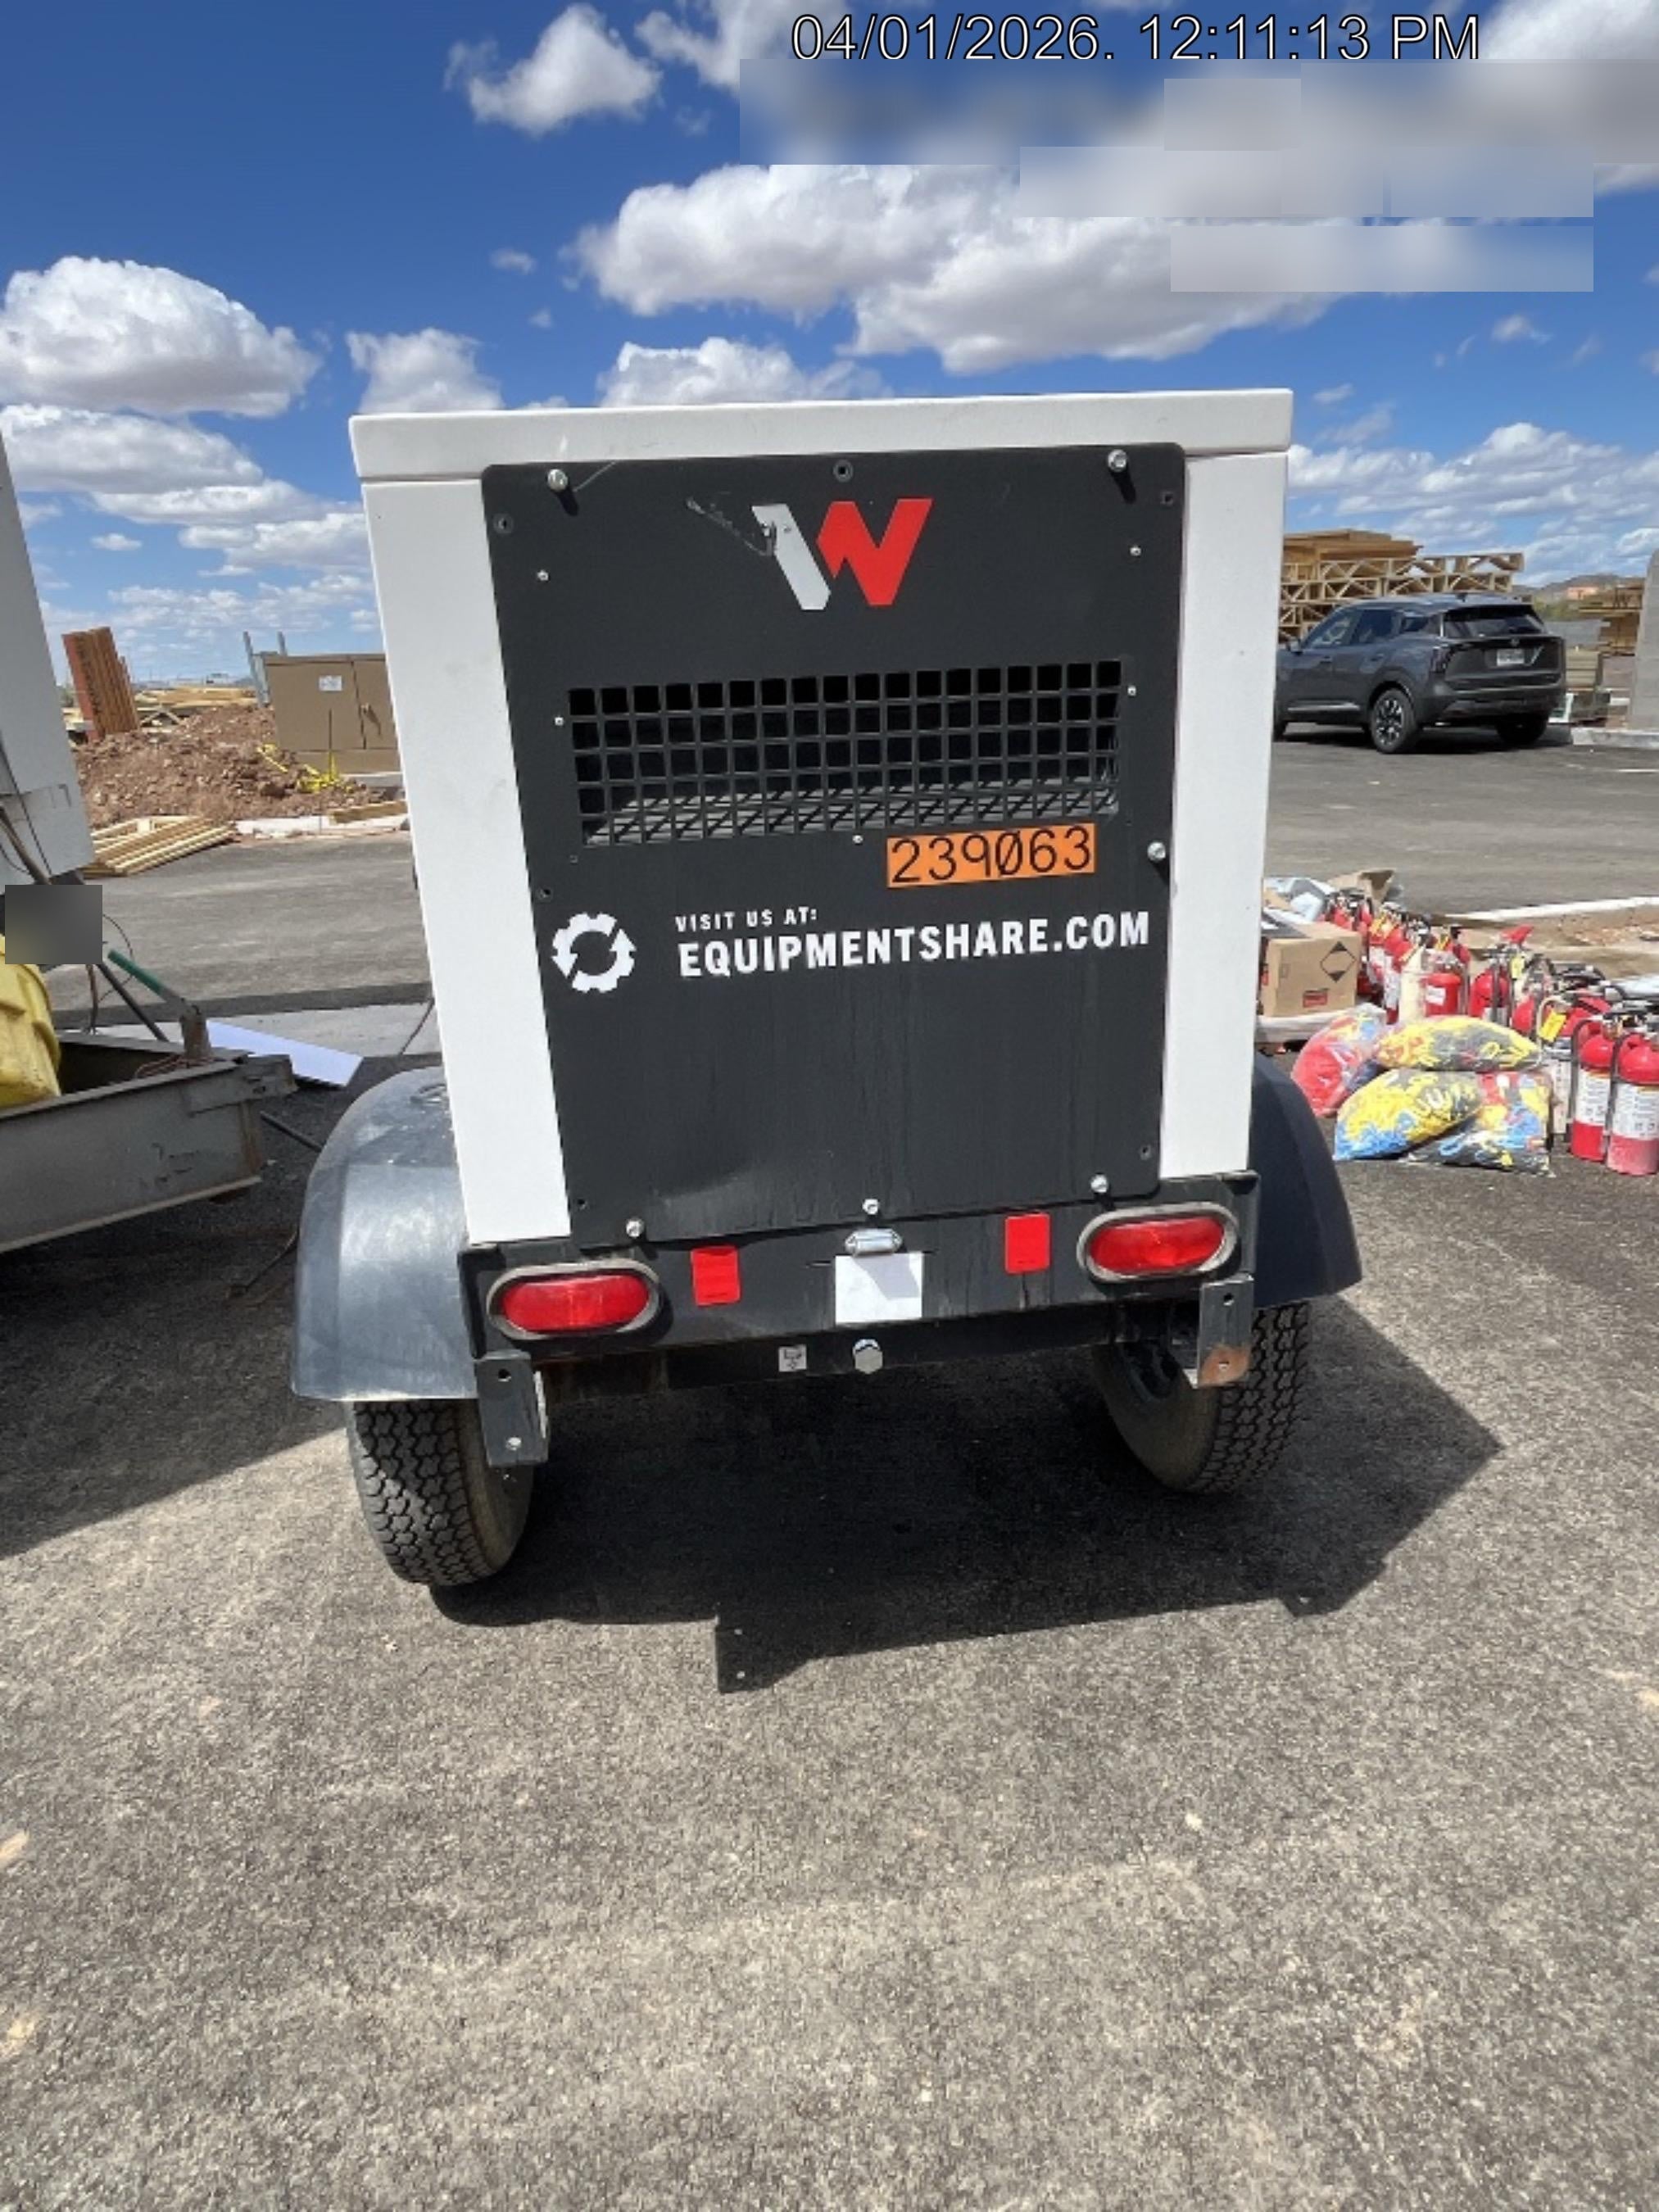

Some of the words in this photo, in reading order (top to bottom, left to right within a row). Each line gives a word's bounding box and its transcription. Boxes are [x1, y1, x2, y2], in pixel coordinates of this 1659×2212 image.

[891, 825, 1091, 883] 239063
[675, 911, 735, 932] VISIT
[746, 909, 773, 927] US
[783, 906, 817, 926] AT:
[678, 910, 1149, 978] EQUIPMENTSHARE.COM
